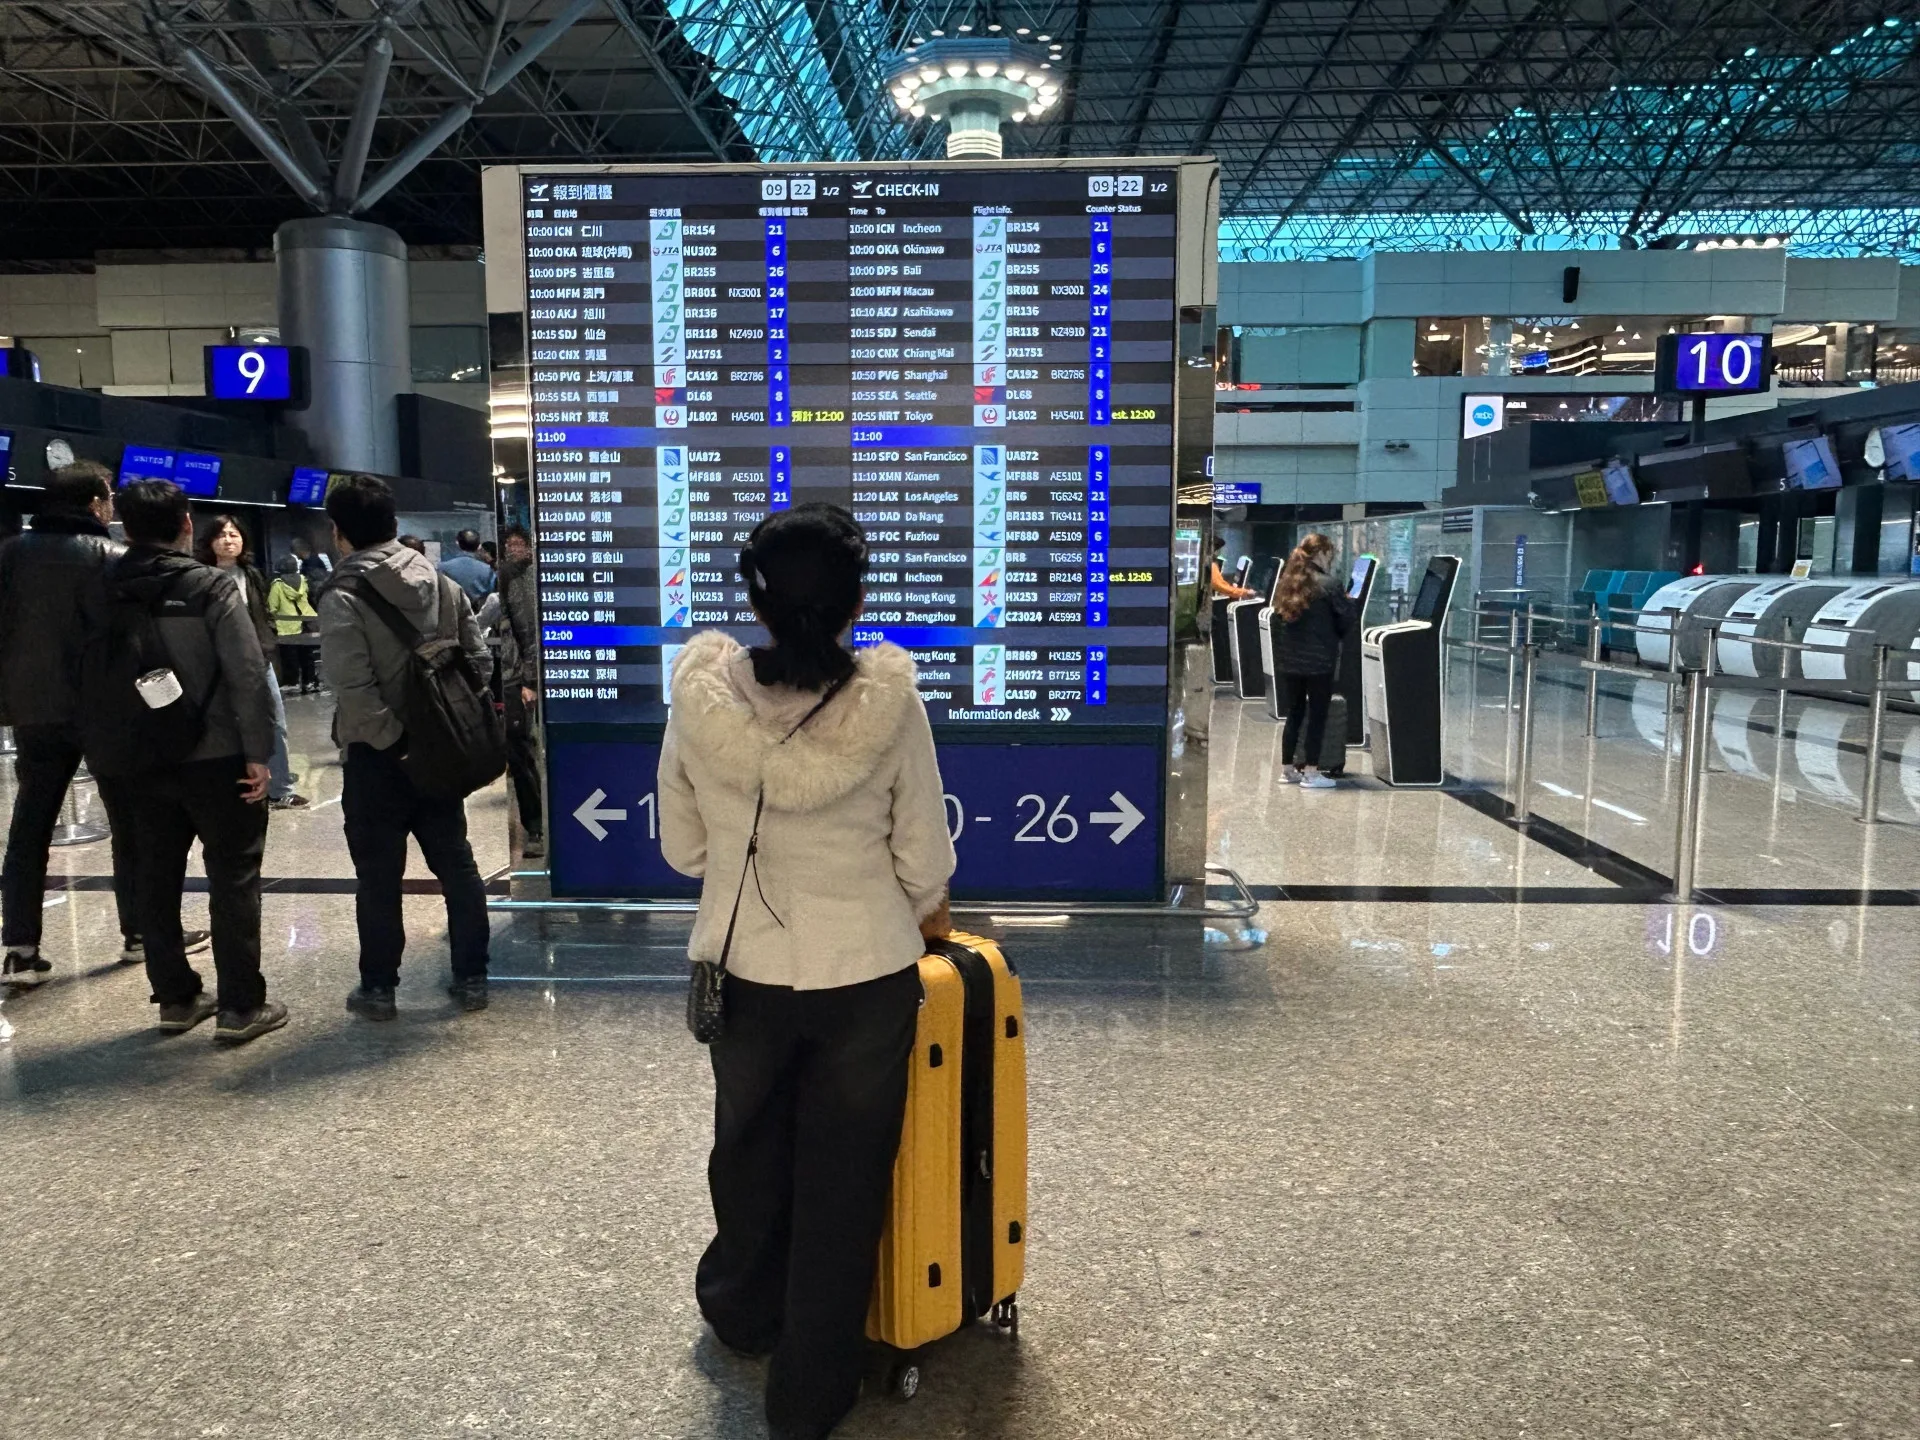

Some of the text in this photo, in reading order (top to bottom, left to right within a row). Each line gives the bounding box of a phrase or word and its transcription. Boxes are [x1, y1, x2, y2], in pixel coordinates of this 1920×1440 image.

[766, 184, 811, 196] 09 22
[822, 187, 839, 196] 1/2
[876, 184, 940, 196] CHECK-IN
[1150, 183, 1168, 192] 1/2
[849, 207, 868, 215] Time
[876, 207, 886, 215] To
[973, 206, 995, 216] Flight
[1086, 205, 1116, 213] Counter
[1118, 205, 1141, 213] Status
[528, 225, 783, 237] 10:00 ICN 仁川 BR154 21
[903, 224, 941, 233] Incheon
[529, 248, 553, 257] 10:00
[555, 247, 577, 257] OKA
[683, 246, 717, 256] NU302
[772, 246, 780, 256] 6
[904, 245, 944, 254] Okinawa
[530, 269, 554, 278] 10:00
[556, 268, 577, 277] DPS
[684, 267, 716, 276] BR255
[769, 267, 784, 276] 26
[904, 266, 921, 275] Bali
[531, 289, 554, 298] 10:00
[557, 288, 580, 298] MFM
[685, 288, 716, 297] BR801
[729, 288, 761, 297] NX3001
[770, 288, 784, 297] 24
[904, 287, 934, 296] Macau
[531, 308, 784, 319] 10:10 AKJ 旭川 17
[904, 307, 953, 316] Asahikawa
[532, 329, 784, 340] 10:15 SDJ 仙台 BR118 NZ4910 21
[904, 328, 936, 337] Sendai
[533, 350, 782, 359] 10:20 2
[904, 348, 954, 360] Chiang Mai
[1690, 340, 1752, 385] 10
[238, 352, 265, 393] 9
[534, 372, 558, 381] 10:50
[560, 372, 580, 381] PVG
[775, 371, 782, 381] 4
[904, 370, 948, 382] Shanghai
[561, 392, 580, 401] SEA
[775, 391, 783, 401] 8
[905, 391, 937, 400] Seattle
[562, 412, 582, 422] NRT
[588, 411, 609, 422] 東京
[732, 412, 764, 421] HA5401
[776, 412, 783, 421] 1
[816, 412, 844, 421] 12:00
[905, 410, 1155, 422] Tokyo est. 12:00
[537, 433, 566, 442] 11:00
[853, 432, 882, 441] 11:00
[563, 452, 783, 462] SFO 9
[905, 452, 968, 461] San Francisco
[564, 472, 784, 482] XMN 5
[905, 472, 940, 481] Xiamen
[1779, 478, 1786, 491] 5
[538, 493, 562, 502] 11:20
[564, 492, 583, 502] LAX
[774, 492, 787, 502] 21
[906, 492, 958, 503] Los Angeles
[539, 512, 585, 521] 11:20 DAD
[906, 512, 1105, 523] Da Nang 21
[540, 532, 563, 541] 11:25
[566, 532, 585, 541] FOC
[906, 532, 1102, 541] Fuzhou 6
[566, 553, 585, 562] SFO
[906, 553, 1104, 562] San Francisco 21
[541, 572, 723, 582] 11:40 ICN 仁川 OZ712
[906, 572, 1152, 582] Incheon 23 est. 12:05
[542, 592, 565, 601] 11:50
[568, 592, 588, 601] HKG
[906, 592, 1104, 604] Hong Kong 25
[543, 611, 589, 621] 11:50 CGO
[906, 612, 1100, 624] Zhengzhou 3
[544, 631, 573, 641] 12:00
[855, 632, 883, 641] 12:00
[570, 650, 591, 659] HKG
[932, 651, 956, 662] Kong
[1090, 652, 1103, 661] 19
[546, 669, 589, 679] 12:30 SZX
[918, 670, 1100, 680] enzhen ZH9072 2
[546, 689, 569, 698] 12:30
[571, 688, 593, 698] HGH
[1005, 690, 1036, 699] CA150
[1092, 691, 1099, 699] 4
[949, 708, 1040, 720] Information desk
[1014, 794, 1078, 843] 26
